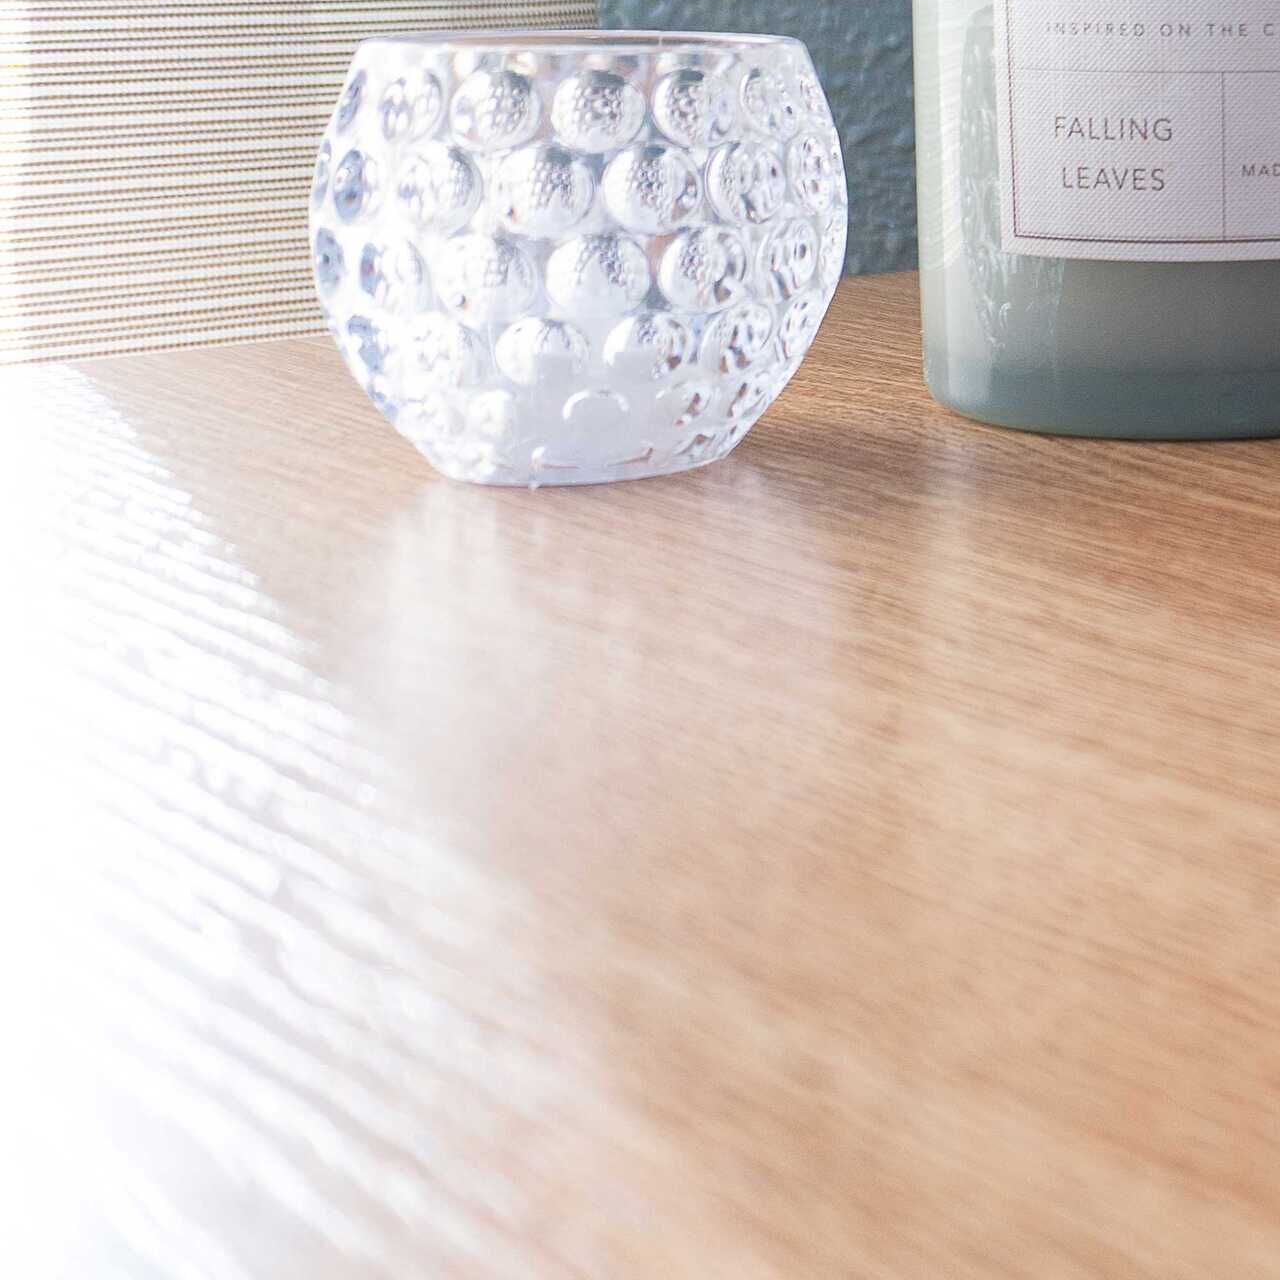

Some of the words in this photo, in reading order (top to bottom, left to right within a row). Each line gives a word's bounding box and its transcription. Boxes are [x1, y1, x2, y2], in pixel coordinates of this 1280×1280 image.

[1046, 21, 1146, 38] INSPIRED
[1159, 22, 1192, 37] ON
[1206, 22, 1249, 37] THE
[1053, 116, 1173, 143] FALLING
[1061, 166, 1166, 192] LEAVES
